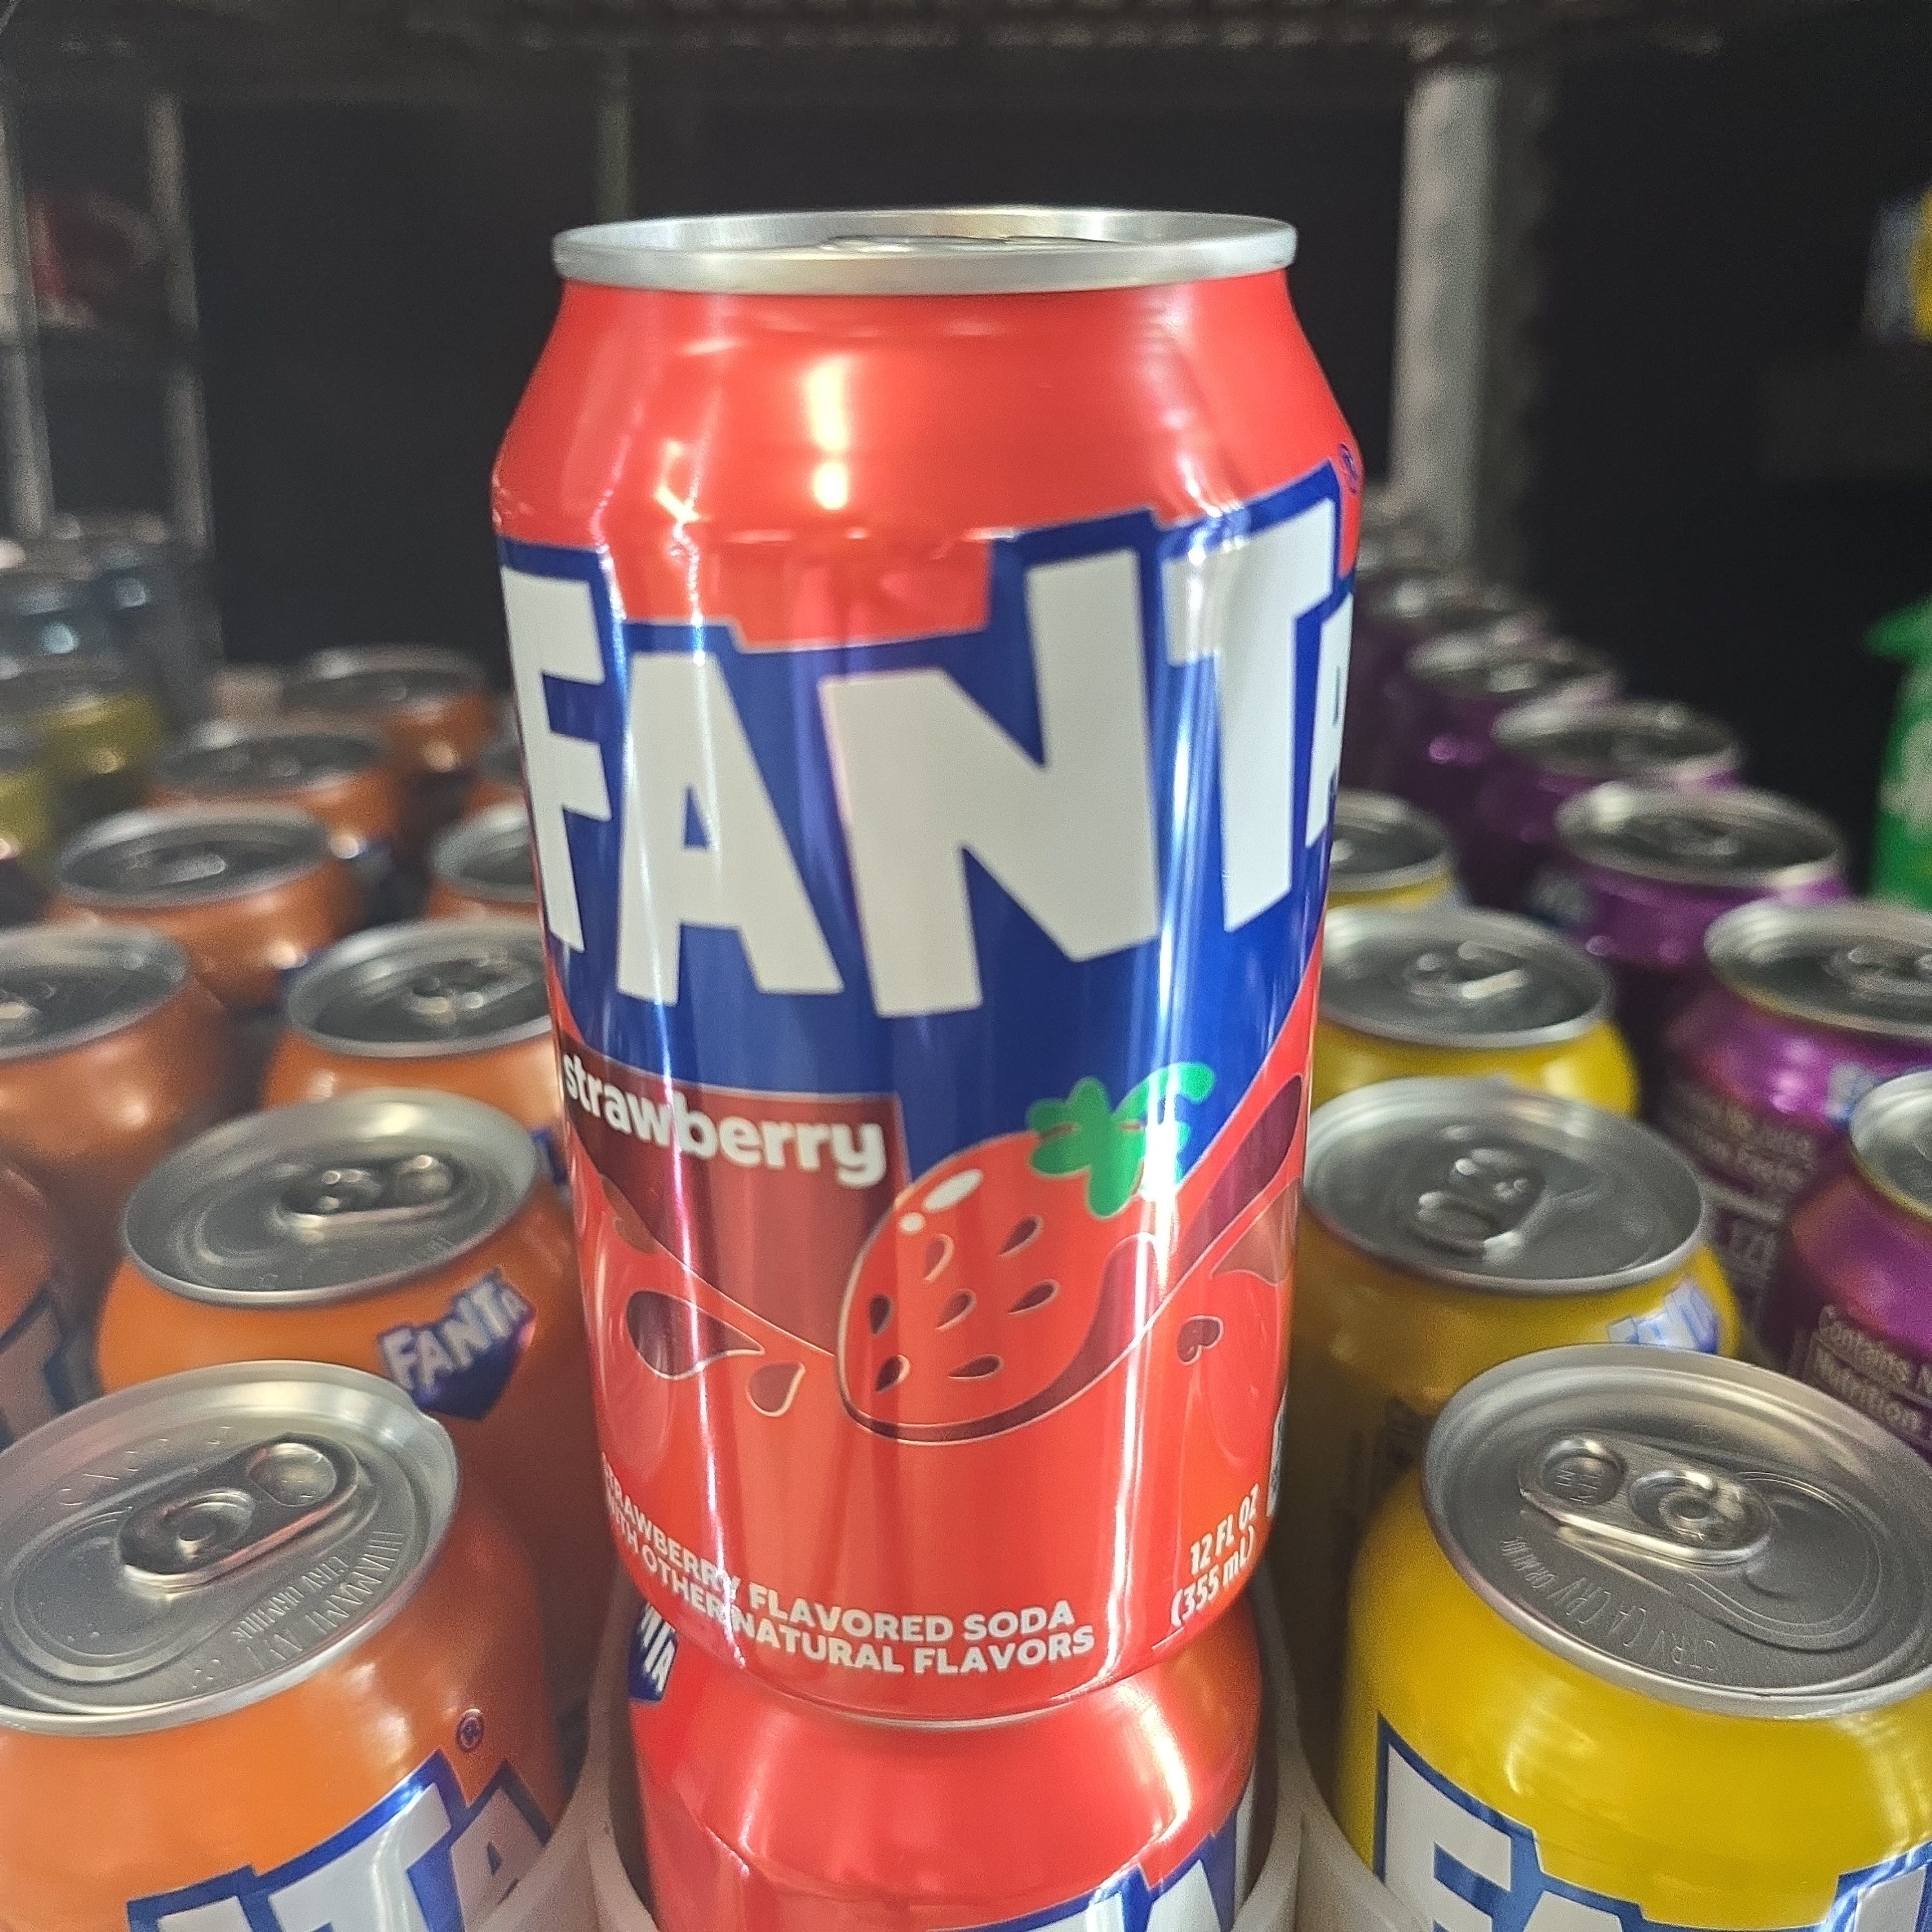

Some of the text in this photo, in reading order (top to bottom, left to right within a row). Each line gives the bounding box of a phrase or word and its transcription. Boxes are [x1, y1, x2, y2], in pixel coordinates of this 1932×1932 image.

[563, 1053, 886, 1187] strawberry
[382, 1280, 529, 1392] FANTA
[1190, 1483, 1259, 1576] 12 FL OZ
[641, 1543, 730, 1627] OTHER
[730, 1604, 904, 1672] NATURAL
[912, 1625, 1096, 1675] FLAVORS
[748, 1581, 953, 1642] FLAVORED
[963, 1599, 1075, 1641] SODA
[1169, 1563, 1220, 1629] (355
